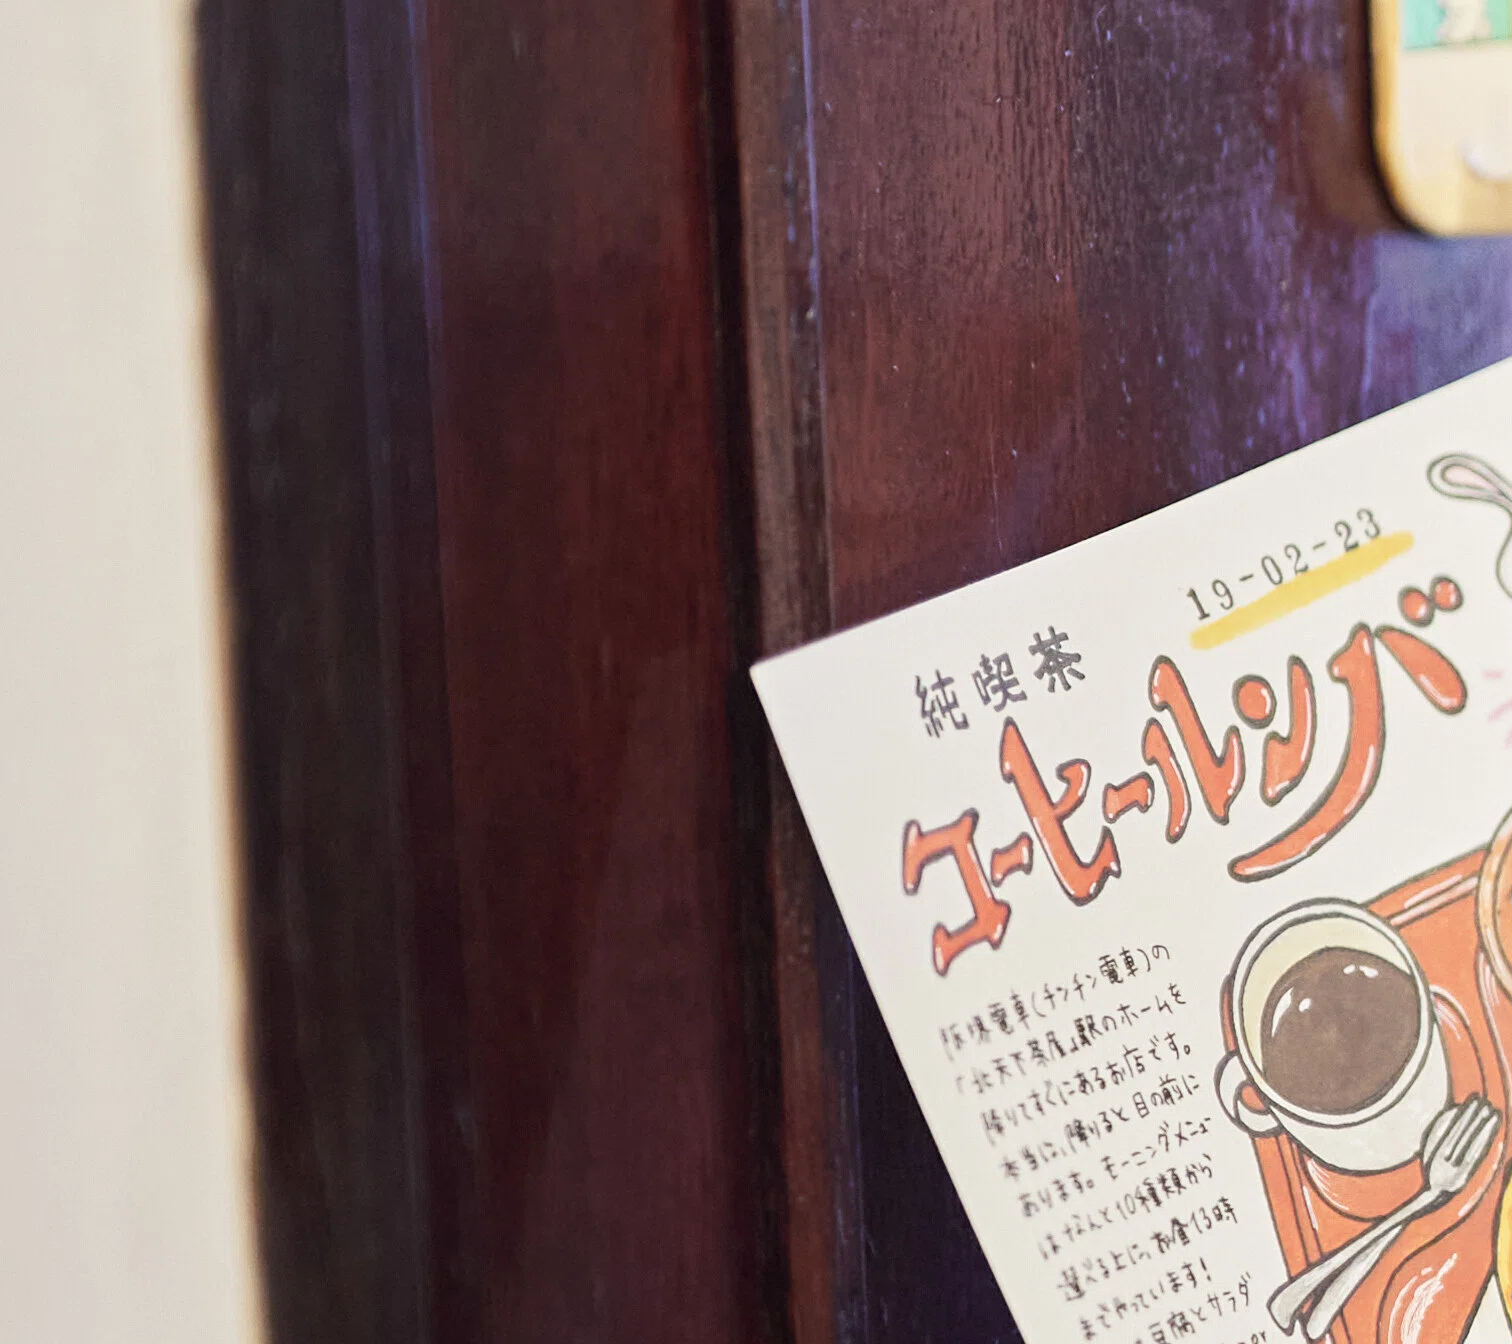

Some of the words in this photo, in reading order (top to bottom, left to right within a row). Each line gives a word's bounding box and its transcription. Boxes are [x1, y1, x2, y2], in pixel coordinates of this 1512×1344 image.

[1185, 508, 1384, 623] 19-02-23
[914, 625, 1087, 739] 純喫茶
[902, 575, 1469, 977] コーヒールンバ
